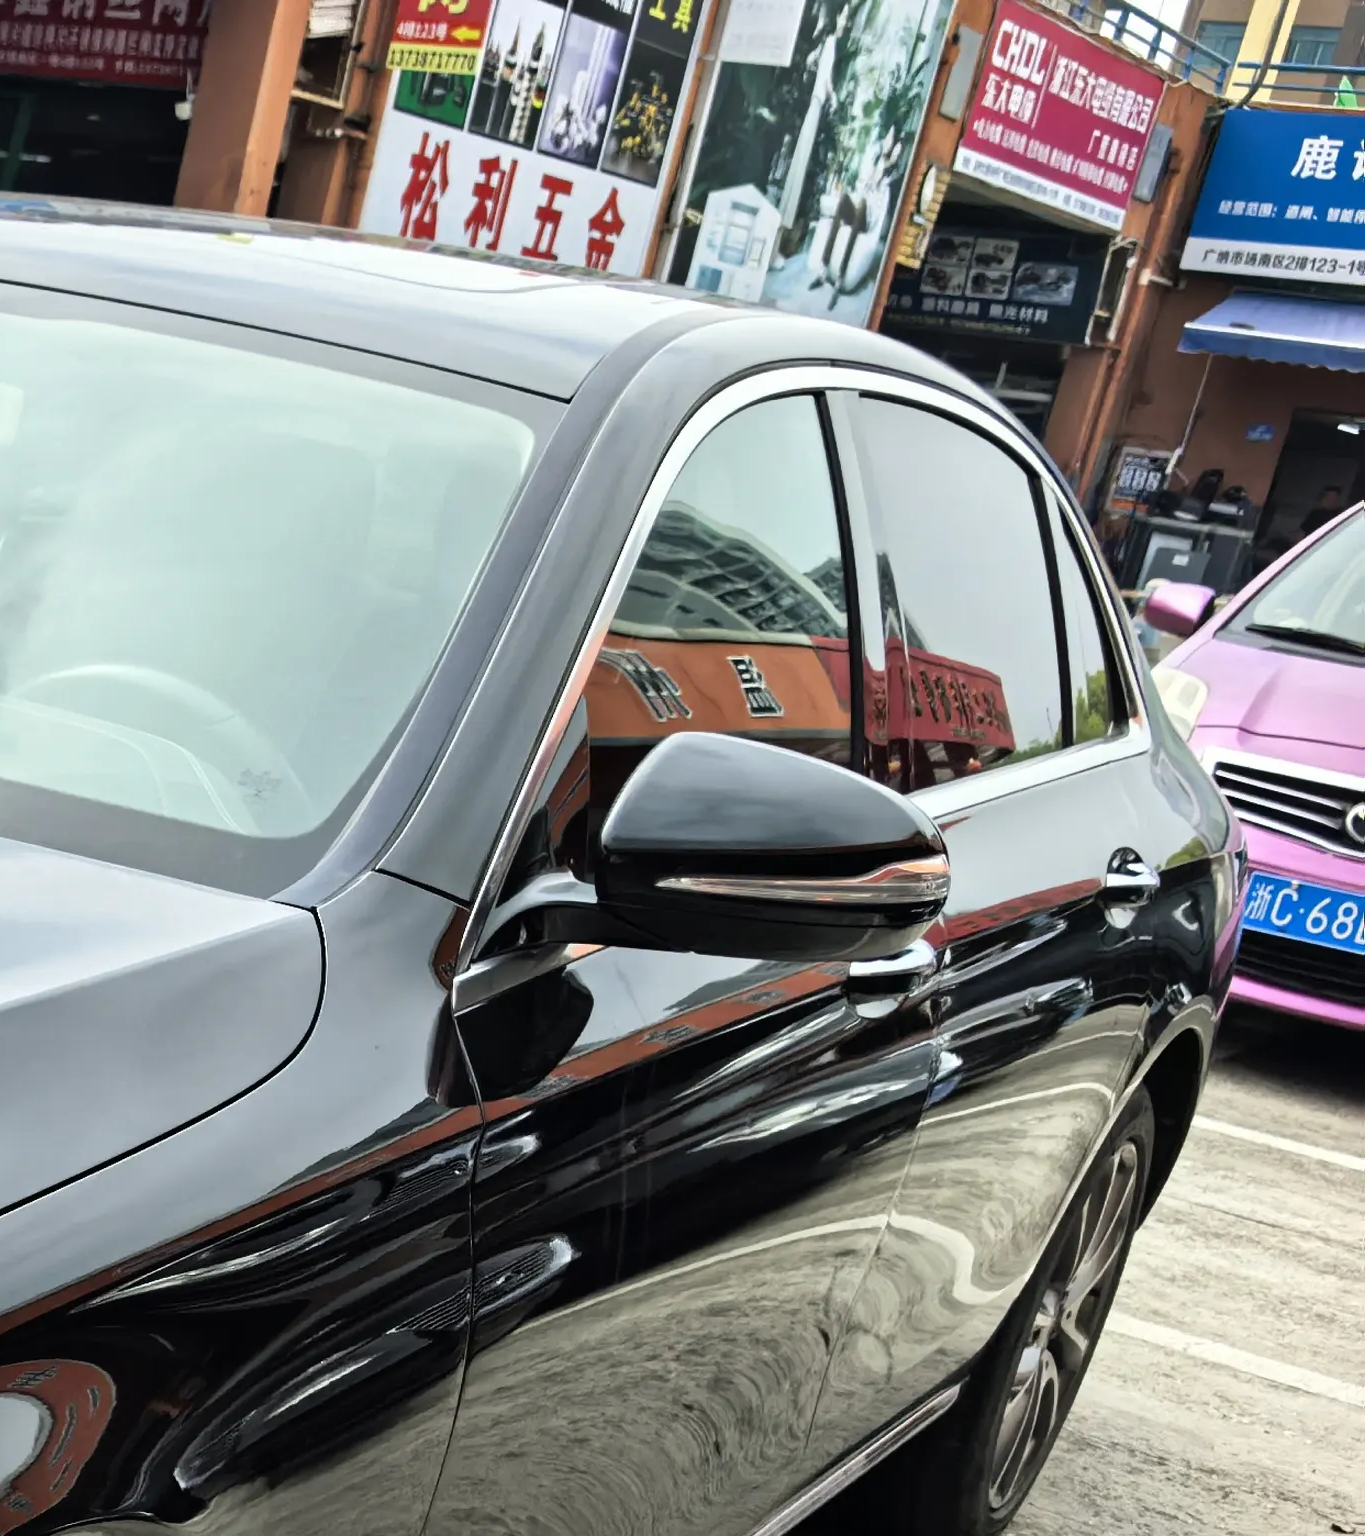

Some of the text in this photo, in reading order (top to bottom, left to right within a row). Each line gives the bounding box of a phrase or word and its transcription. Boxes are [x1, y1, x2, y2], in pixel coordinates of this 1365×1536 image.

[991, 19, 1047, 86] CHDL
[399, 131, 625, 271] 松利五金
